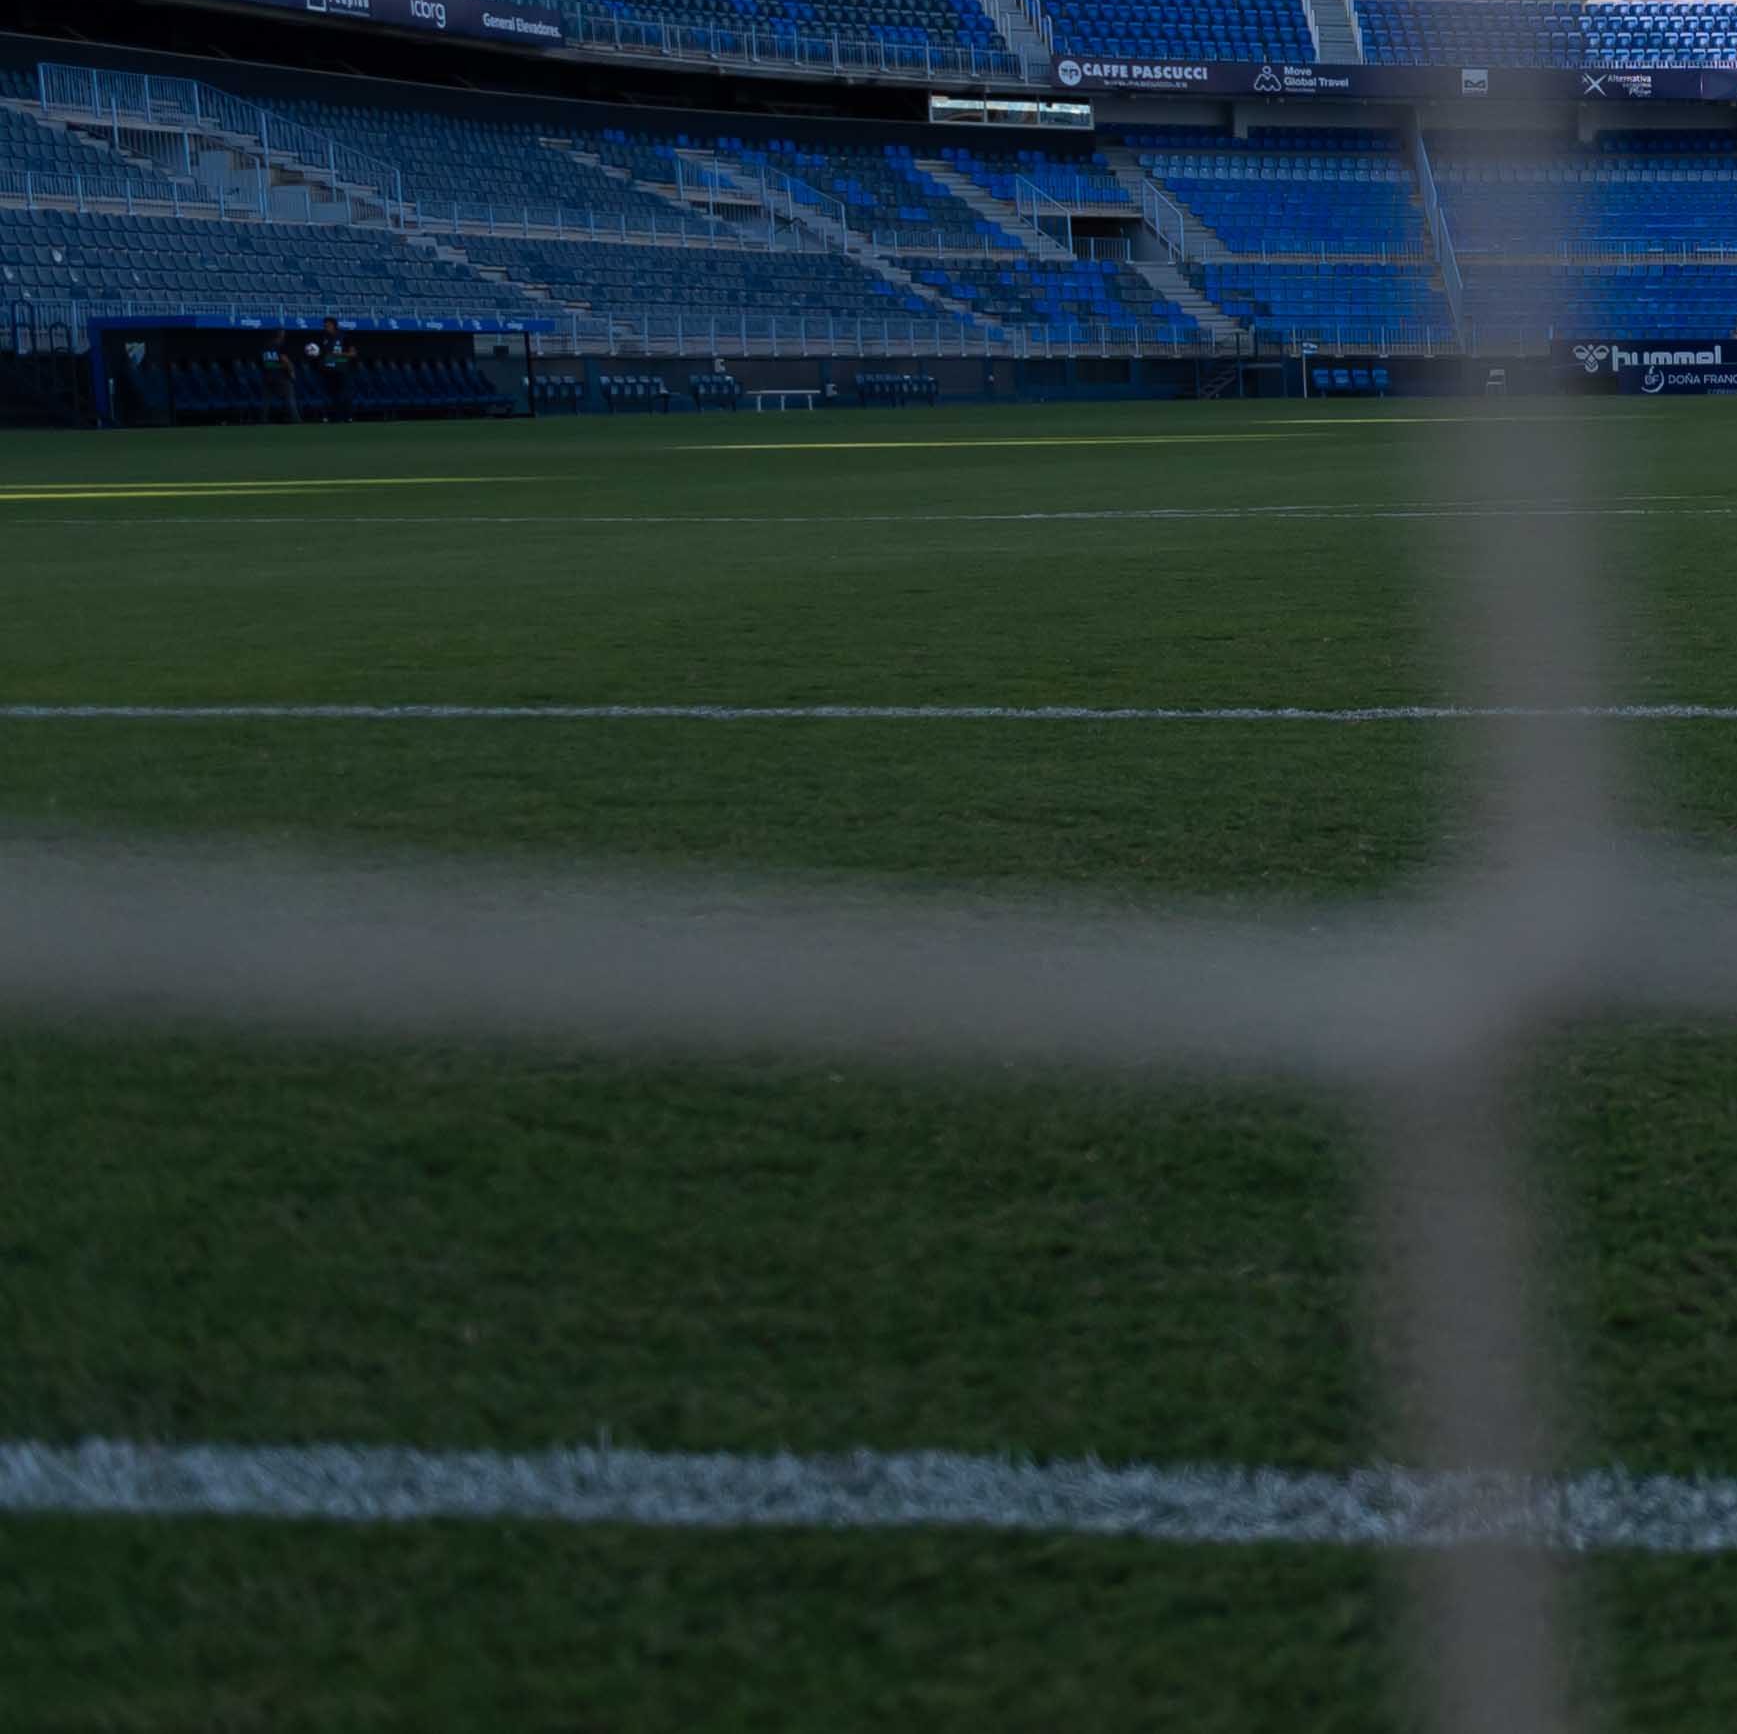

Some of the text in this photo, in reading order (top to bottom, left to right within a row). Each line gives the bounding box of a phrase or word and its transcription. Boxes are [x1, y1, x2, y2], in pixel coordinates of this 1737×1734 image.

[483, 13, 515, 32] General
[1132, 65, 1208, 80] PASCUCCI
[1284, 66, 1312, 75] Move
[1284, 77, 1348, 87] Global Travel
[1612, 345, 1722, 371] hummel
[1668, 372, 1700, 384] DOÑA
